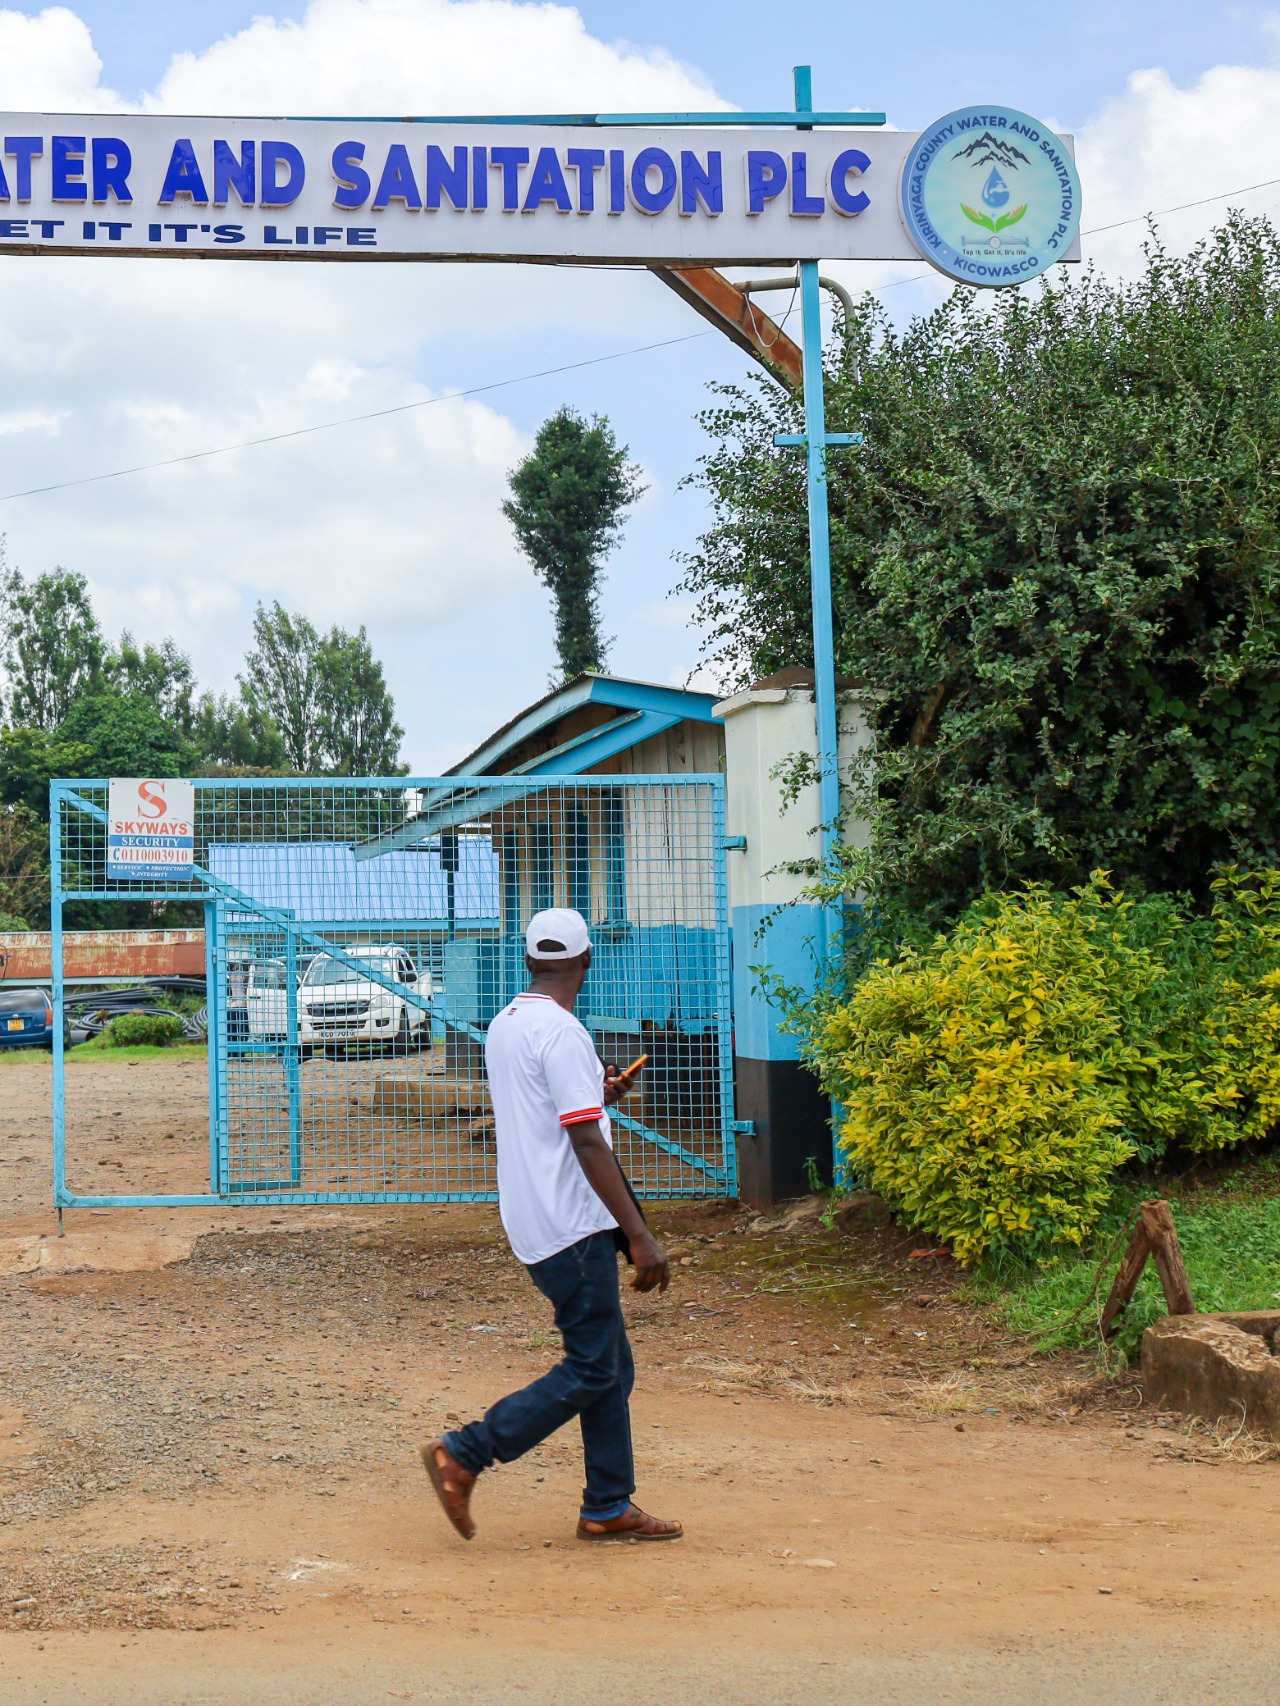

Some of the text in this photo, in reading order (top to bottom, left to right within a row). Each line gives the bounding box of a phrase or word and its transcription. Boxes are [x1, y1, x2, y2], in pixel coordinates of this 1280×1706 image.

[158, 137, 306, 208] AND
[331, 141, 723, 217] SANITATION
[745, 149, 872, 218] PLC
[911, 115, 1073, 249] KIRINYAGA COUNTY WATER AND SANITATION PLC
[83, 221, 132, 240] IT
[149, 223, 246, 243] IT'S
[264, 226, 377, 245] LIFE
[953, 256, 1039, 277] KICOWASCO
[138, 780, 168, 819] S
[114, 821, 188, 836] SKYWAYS
[121, 836, 180, 847] SECURITY
[121, 848, 188, 863] 0110003910
